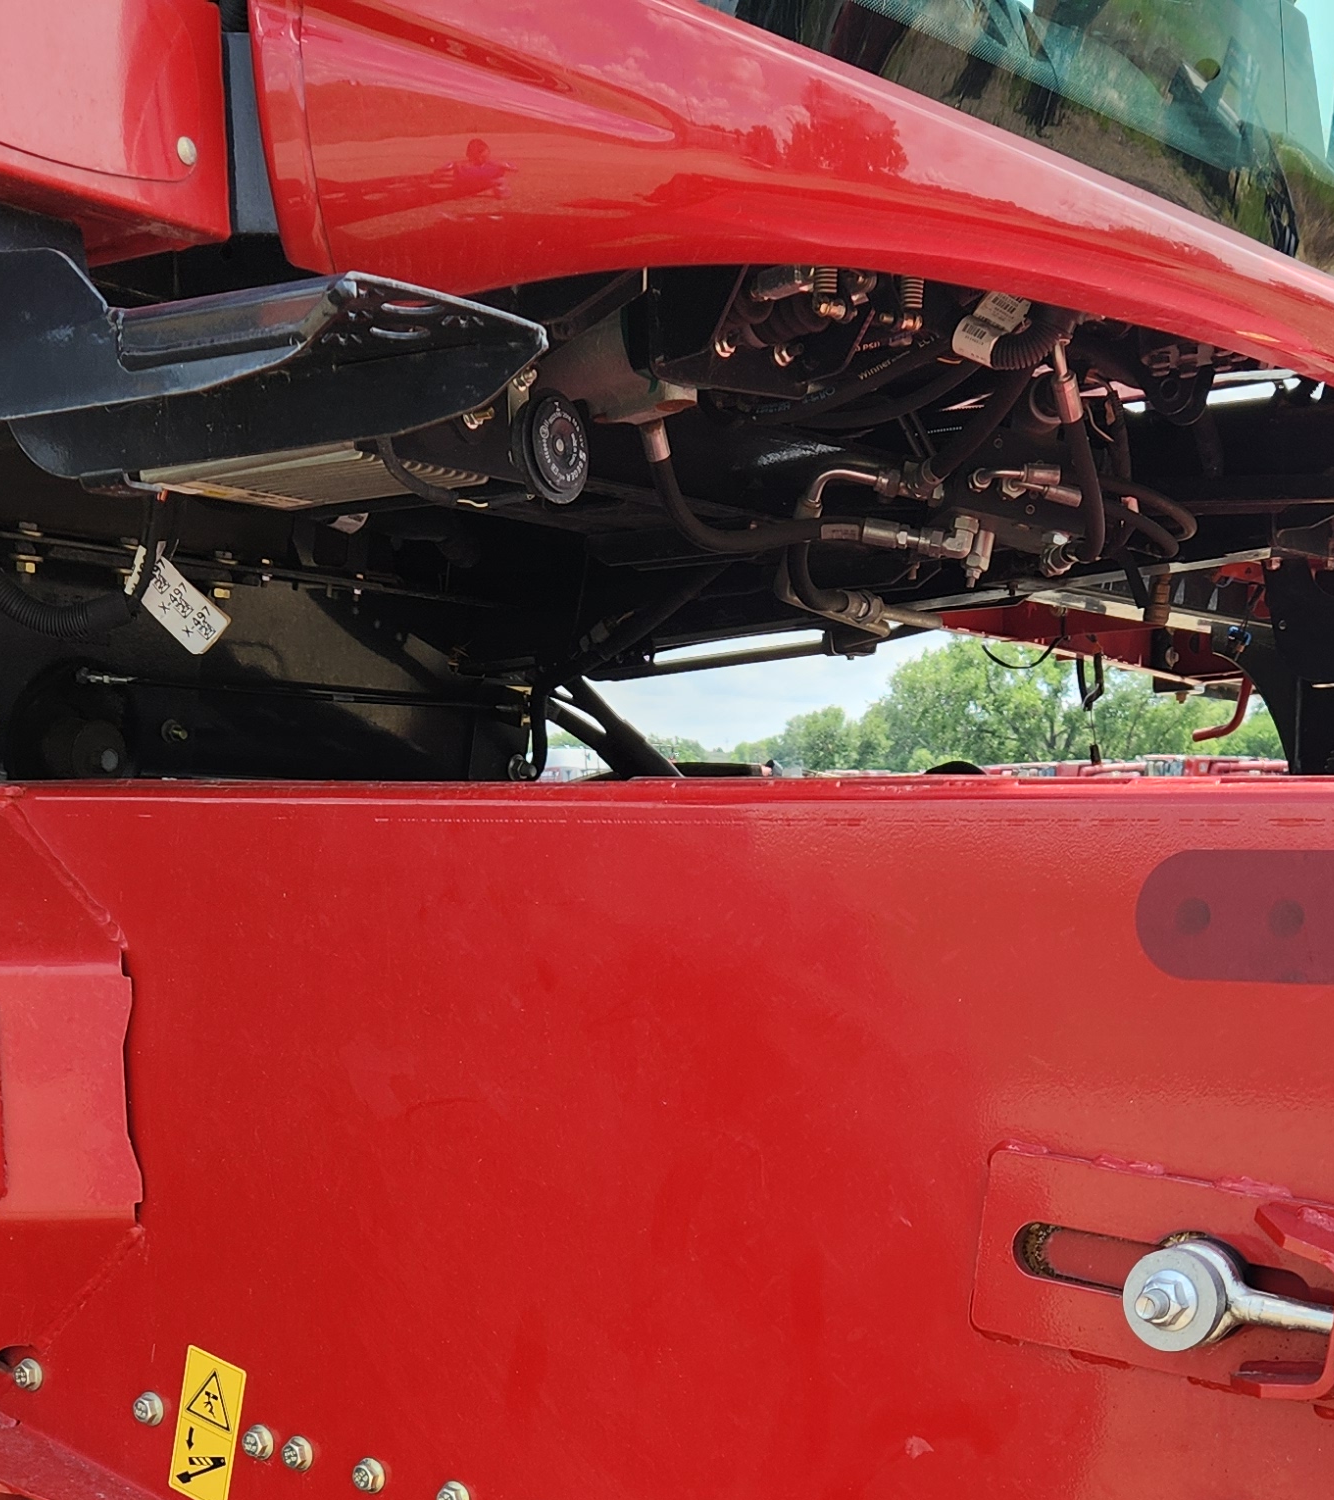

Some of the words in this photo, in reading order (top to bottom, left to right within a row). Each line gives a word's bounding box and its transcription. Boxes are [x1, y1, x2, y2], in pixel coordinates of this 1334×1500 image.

[858, 359, 892, 380] Winner
[158, 582, 187, 614] X-497
[182, 606, 211, 637] X-497
